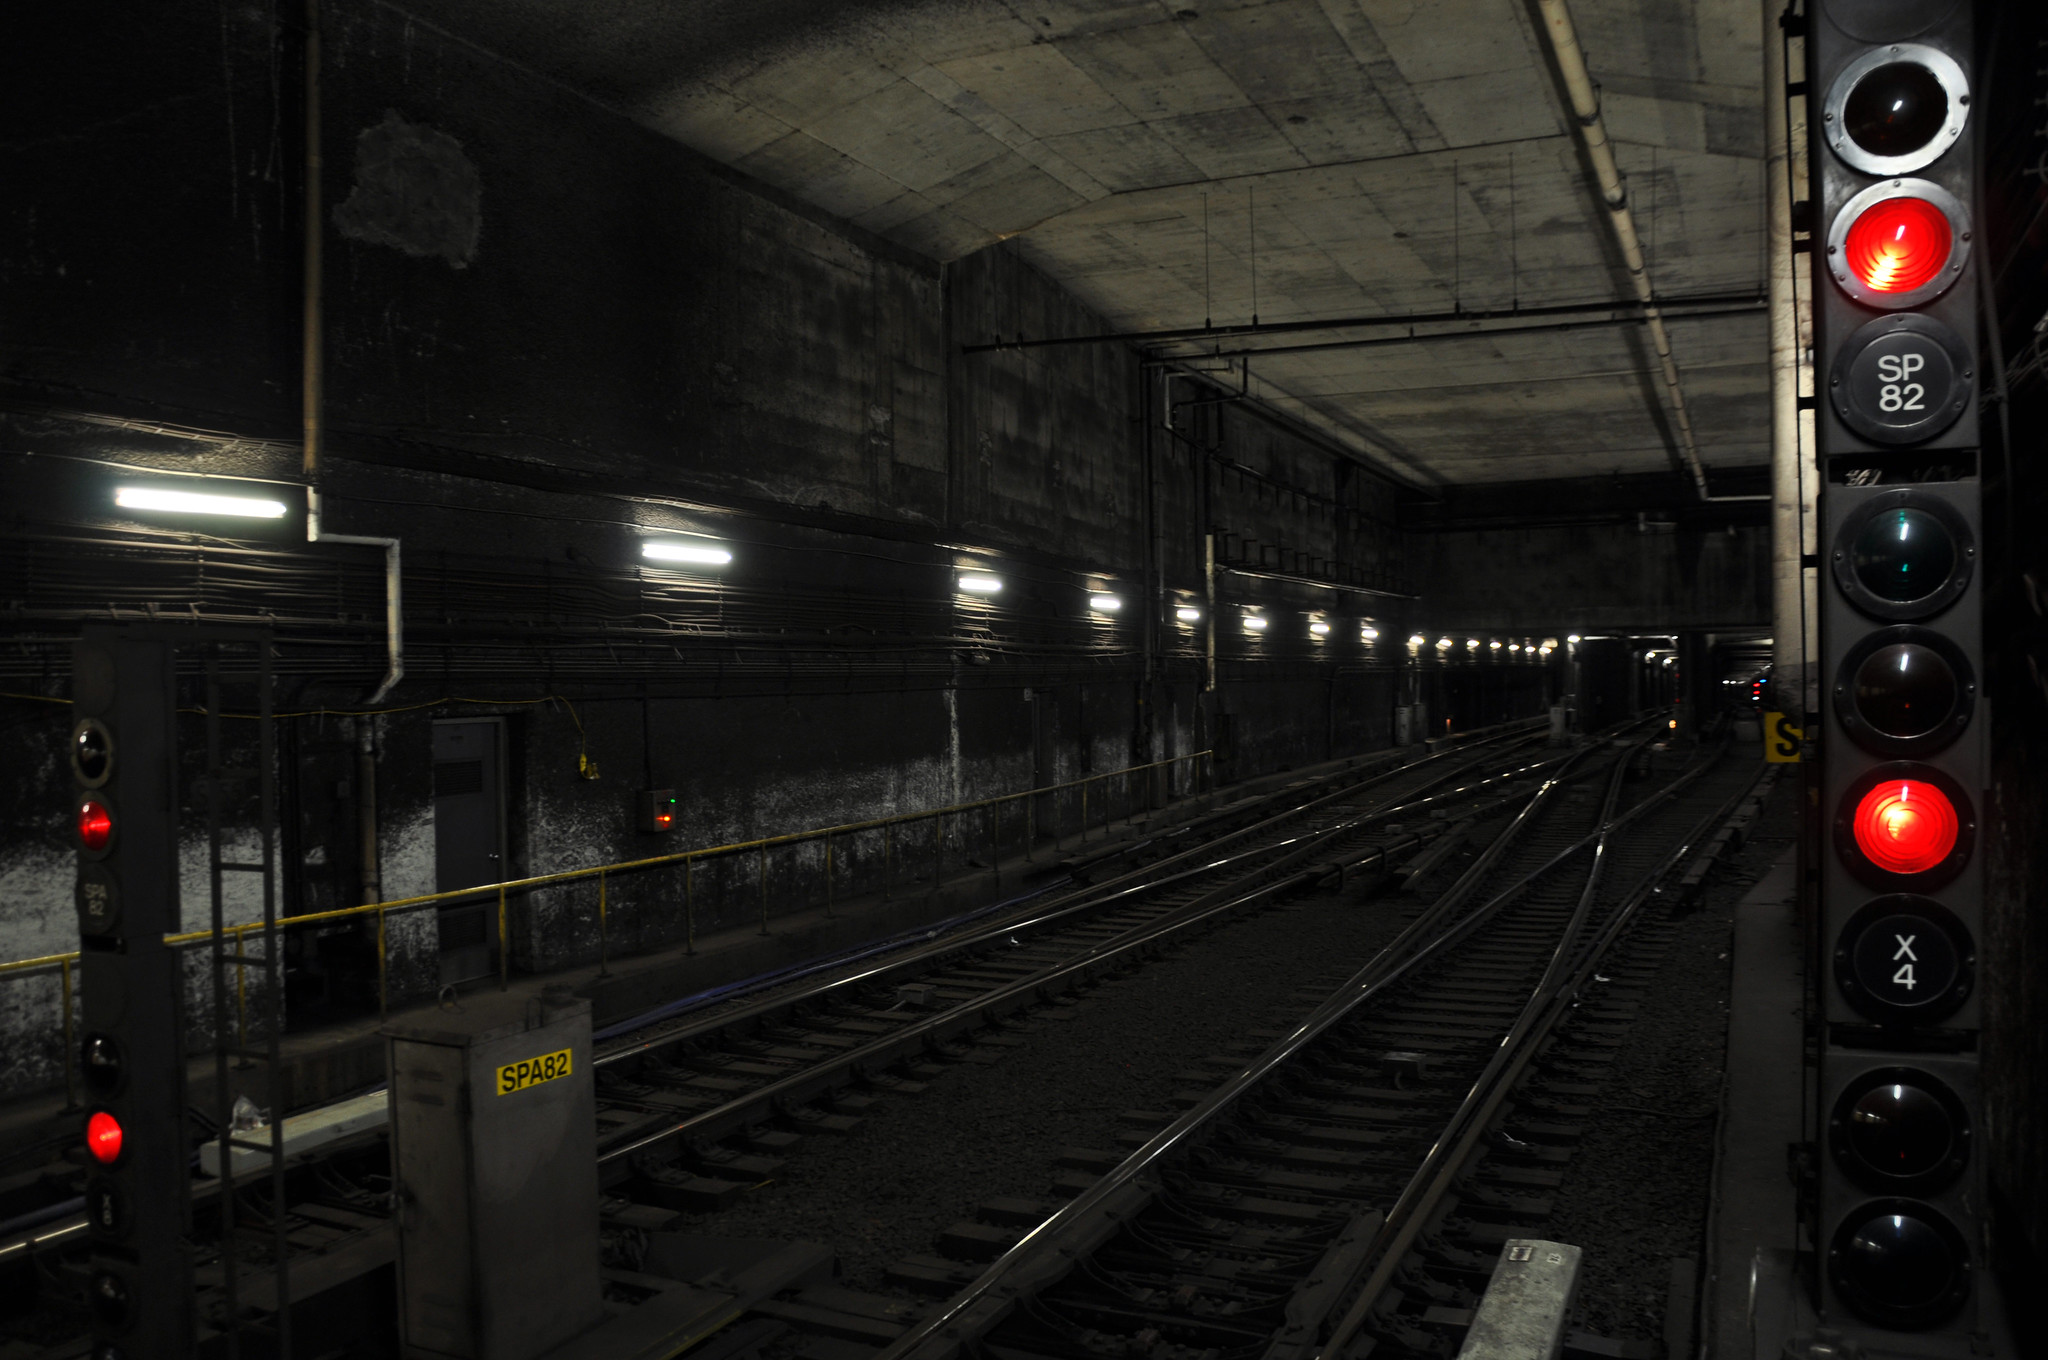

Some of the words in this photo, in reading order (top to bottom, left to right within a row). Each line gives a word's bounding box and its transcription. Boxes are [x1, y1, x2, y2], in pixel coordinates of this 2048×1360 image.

[1877, 353, 1925, 383] SP
[1879, 384, 1925, 412] 82
[1776, 717, 1799, 757] S
[84, 883, 108, 900] SPA
[88, 899, 104, 916] 82
[1892, 934, 1917, 962] X
[1892, 963, 1917, 991] 4
[502, 1053, 568, 1093] SPA82
